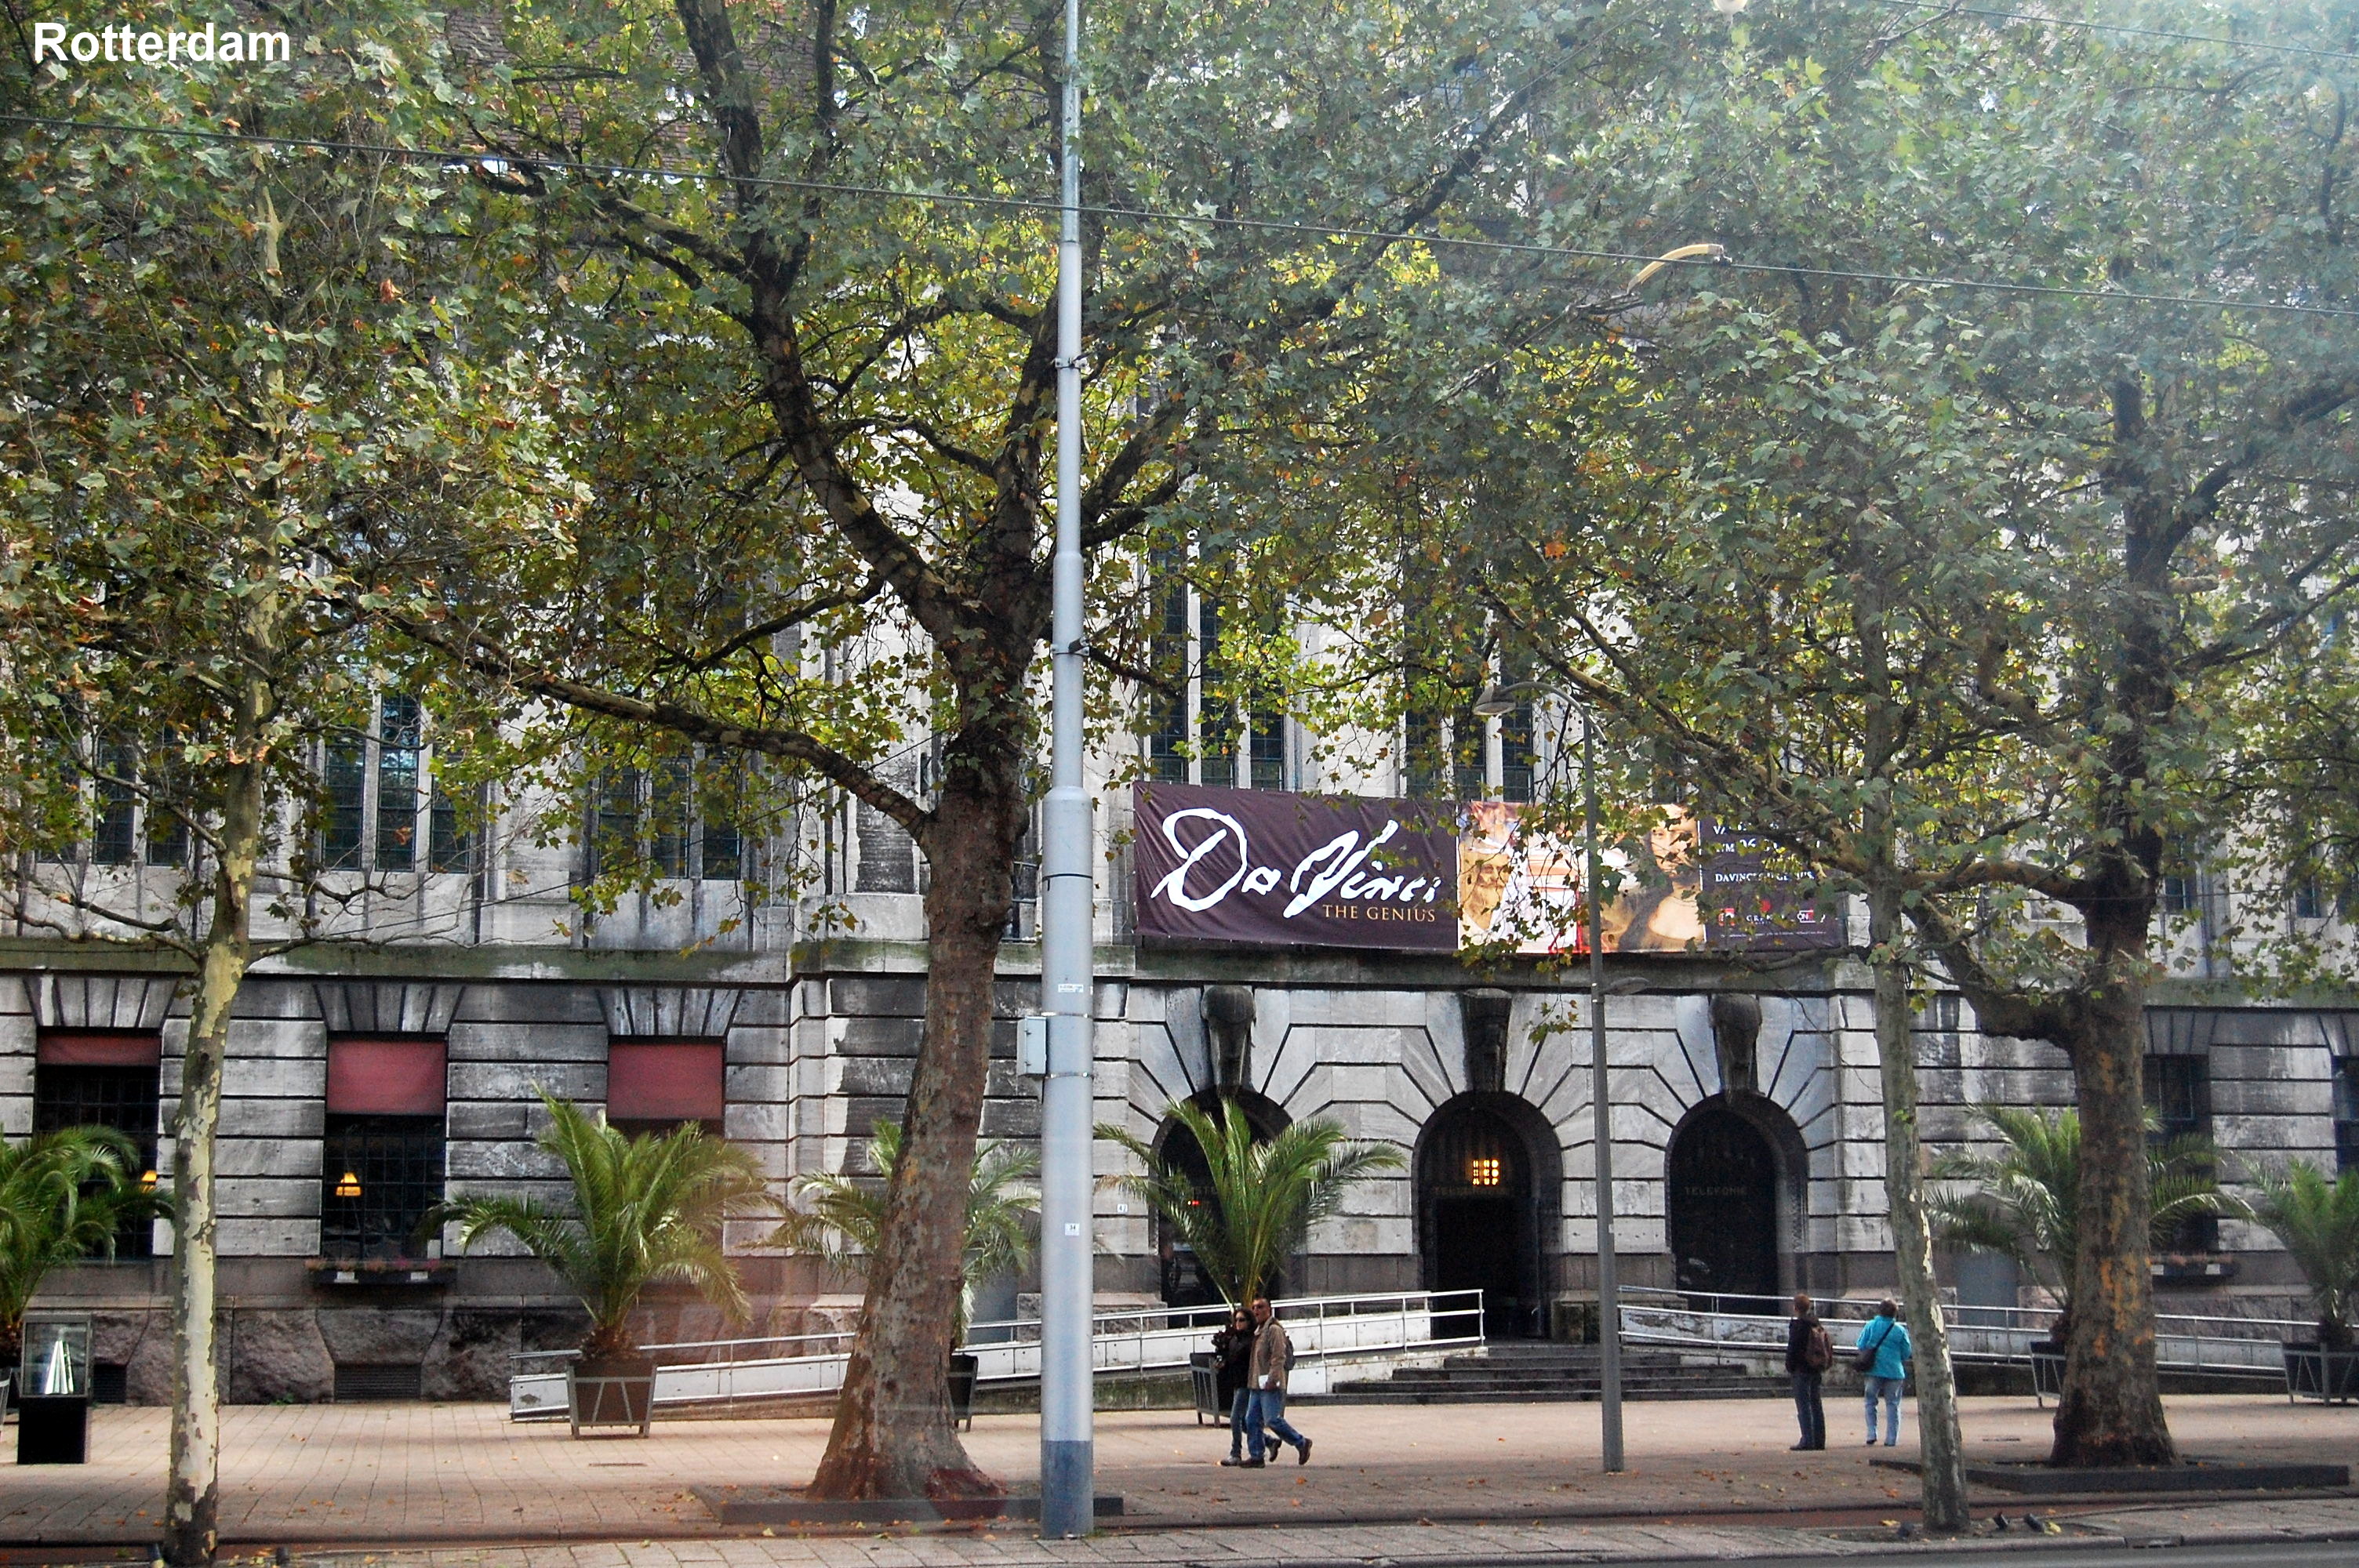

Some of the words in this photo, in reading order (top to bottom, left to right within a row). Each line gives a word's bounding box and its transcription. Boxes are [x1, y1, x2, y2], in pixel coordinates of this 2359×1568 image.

[1150, 808, 1281, 913] Da
[1283, 819, 1441, 919] Vinci
[1323, 905, 1358, 918] THE
[1367, 907, 1435, 922] GENIUS
